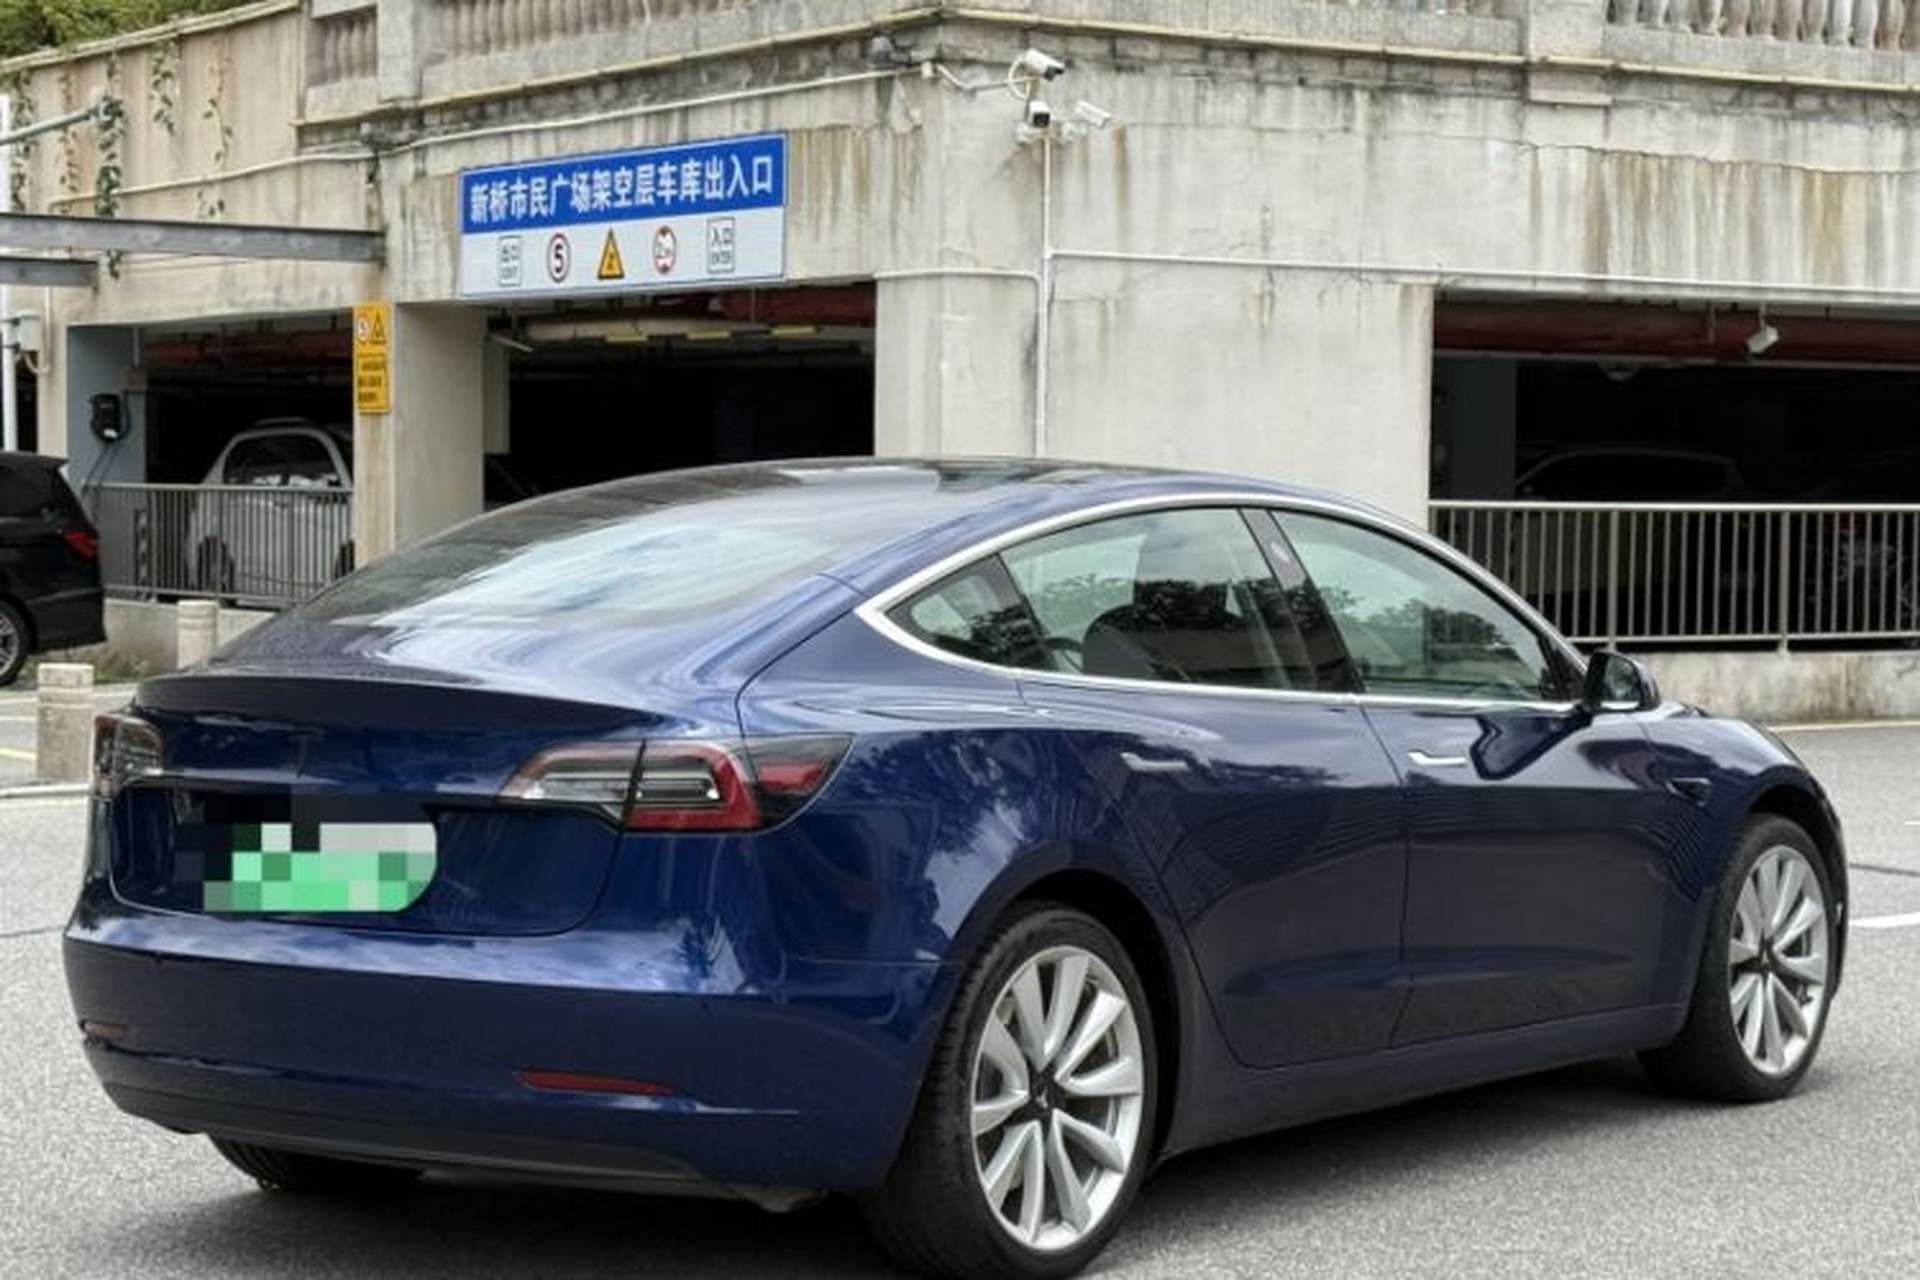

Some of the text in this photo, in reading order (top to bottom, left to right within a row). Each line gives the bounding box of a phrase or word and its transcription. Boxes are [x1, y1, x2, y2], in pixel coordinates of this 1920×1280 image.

[470, 153, 773, 225] 新桥市民广场架空层车库出入口
[555, 243, 564, 274] 5
